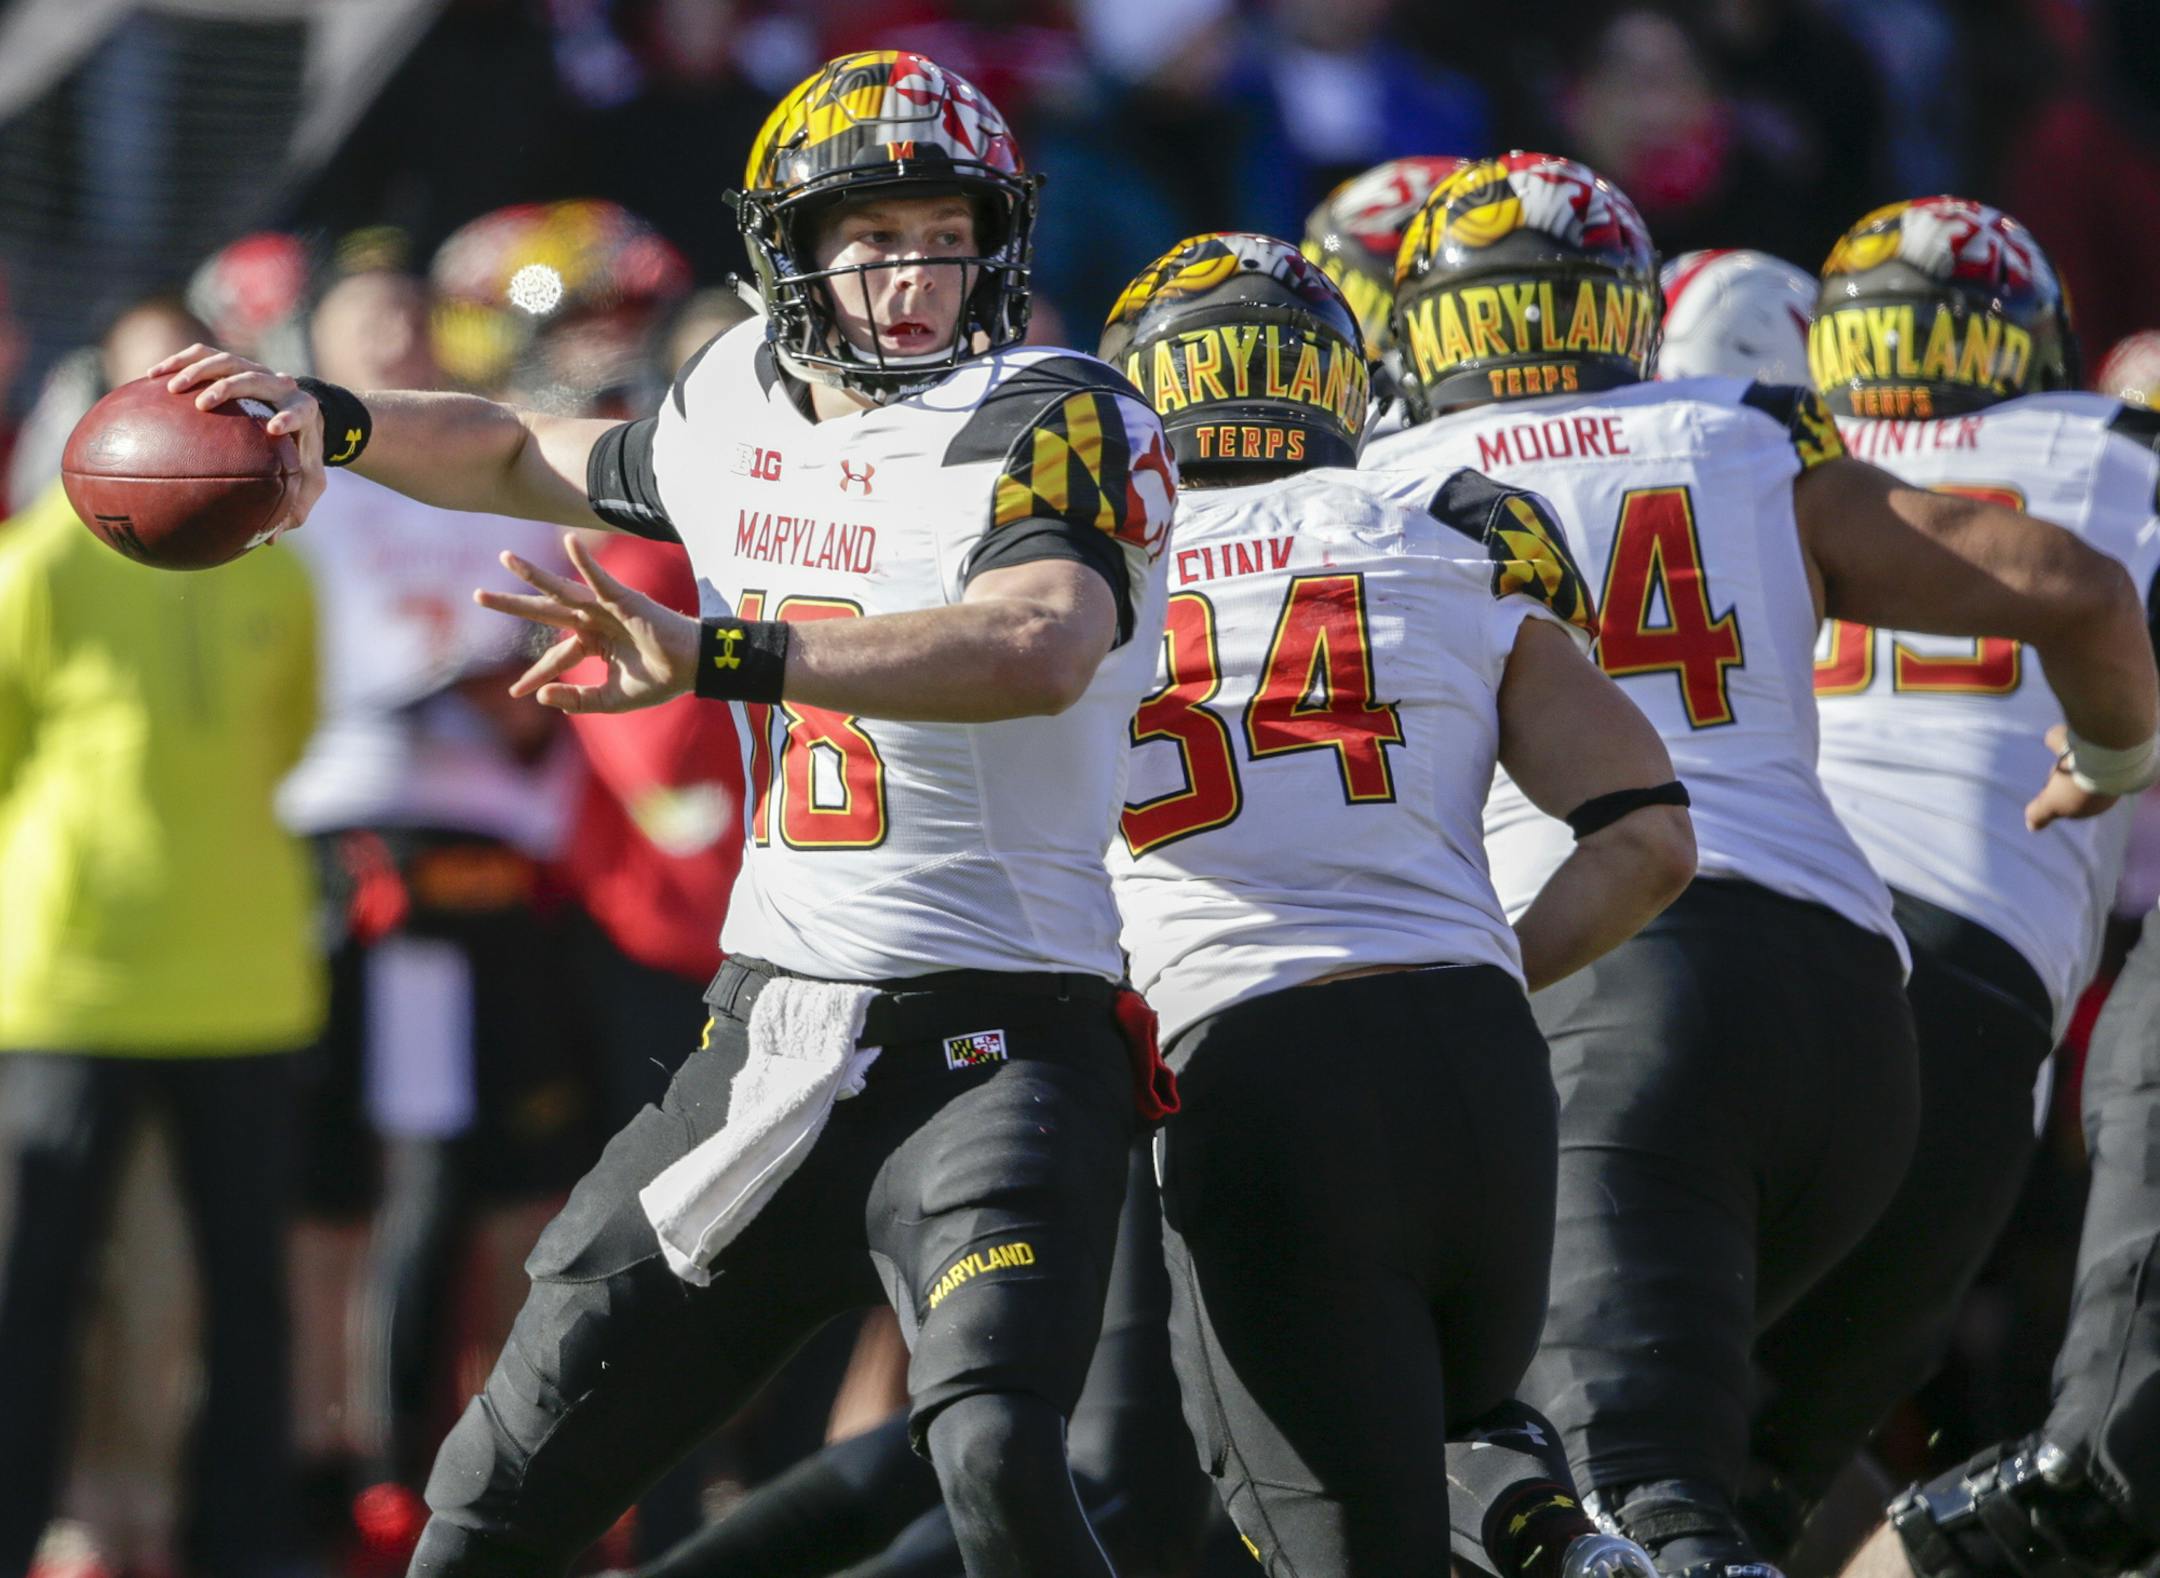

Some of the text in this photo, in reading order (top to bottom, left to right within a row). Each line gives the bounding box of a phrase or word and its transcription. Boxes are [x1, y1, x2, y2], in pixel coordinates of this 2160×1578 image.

[1407, 280, 1652, 385] MARYLAND
[1488, 364, 1579, 398] TERPS
[1851, 386, 1934, 418] TERPS
[1196, 426, 1306, 461] TERPS
[1477, 415, 1631, 473] MOORE
[734, 509, 876, 575] MARYLAND
[735, 588, 889, 852] 18
[1118, 572, 1407, 863] 34
[927, 1241, 1036, 1309] MARYLAND
